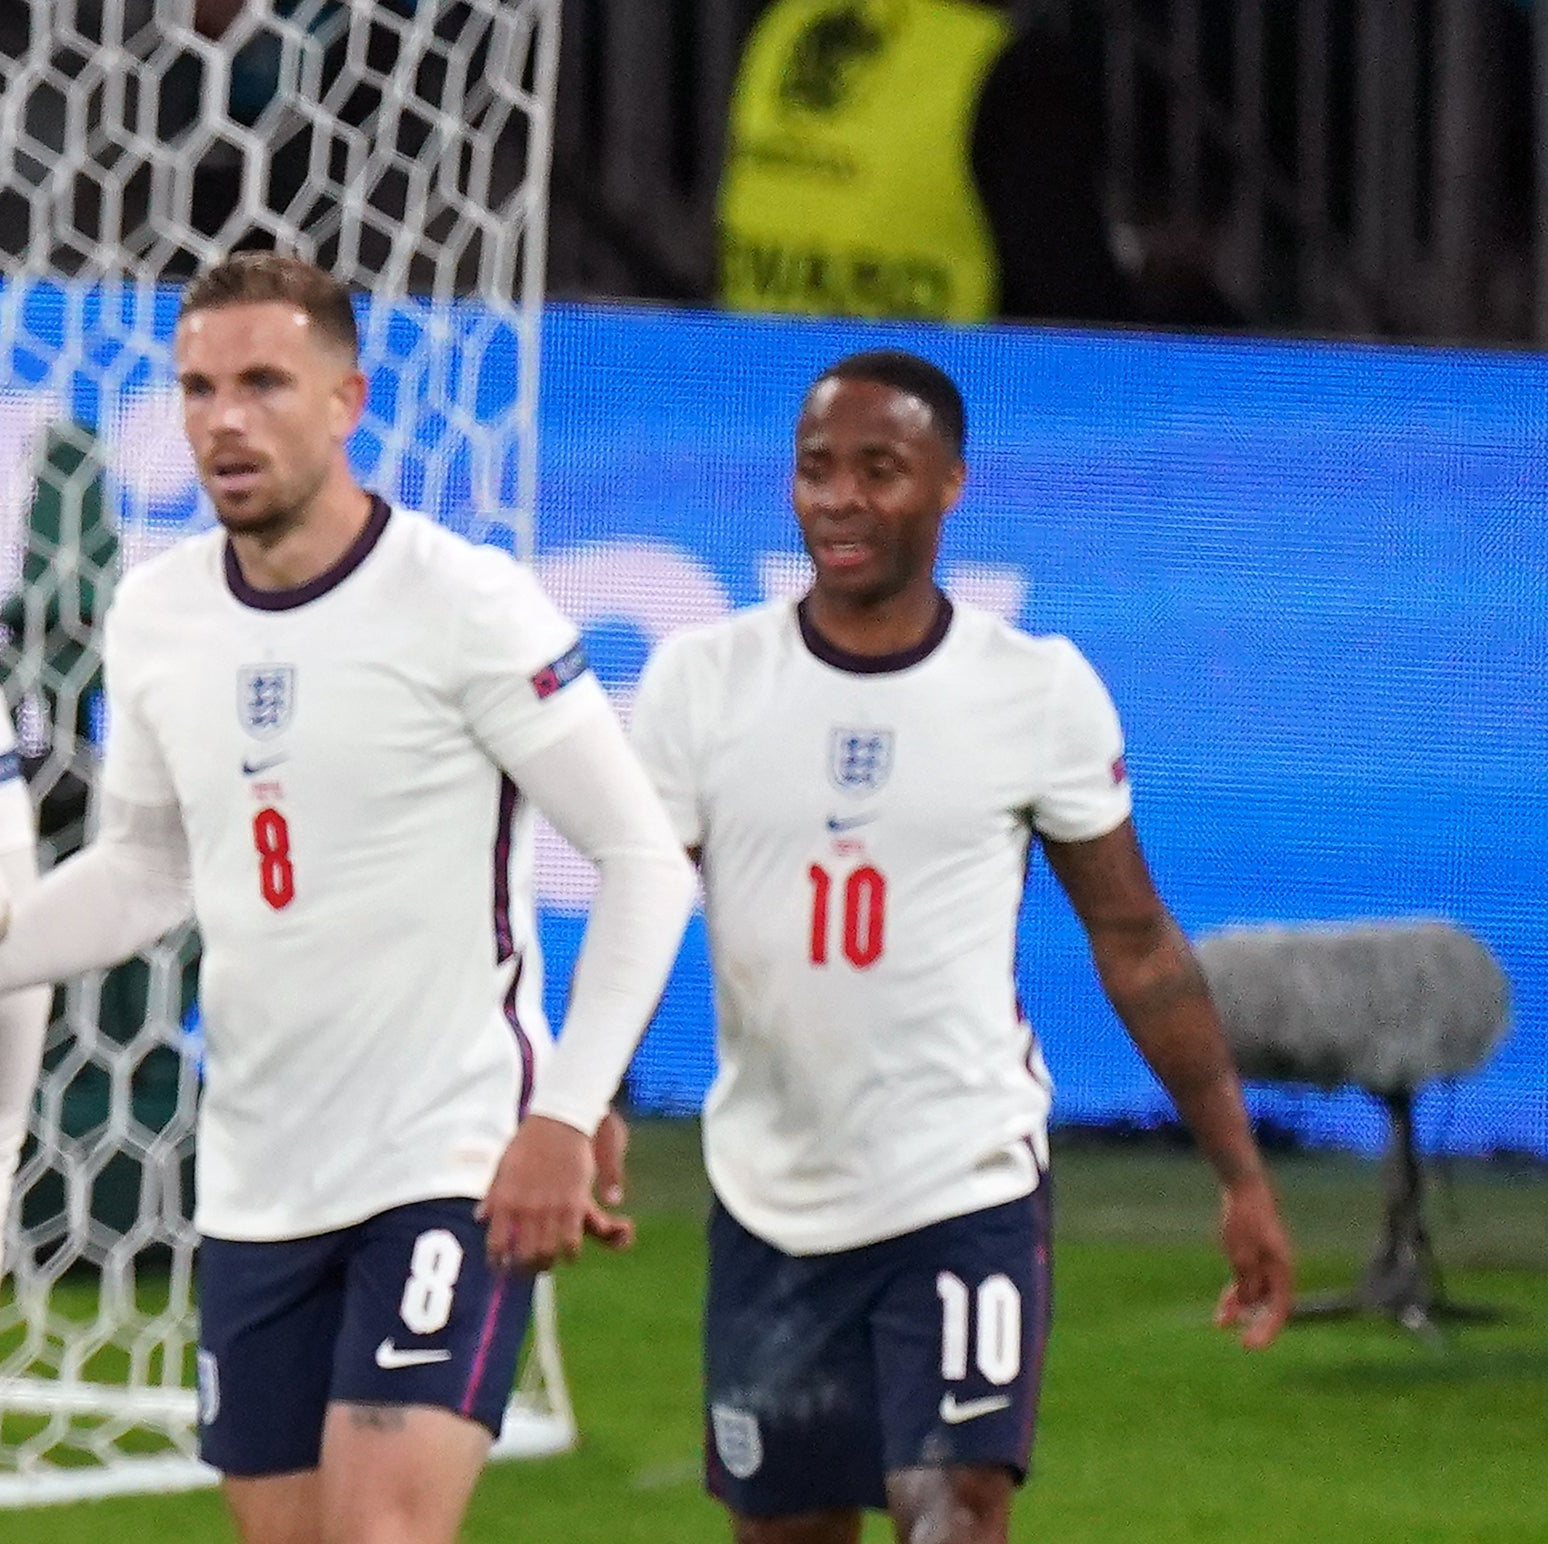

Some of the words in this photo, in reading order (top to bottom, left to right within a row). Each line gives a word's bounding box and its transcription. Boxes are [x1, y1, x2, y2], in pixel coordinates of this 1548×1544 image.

[254, 808, 294, 909] 8
[808, 864, 887, 970] 10
[399, 1228, 464, 1336] 8
[936, 1270, 1022, 1386] 10
